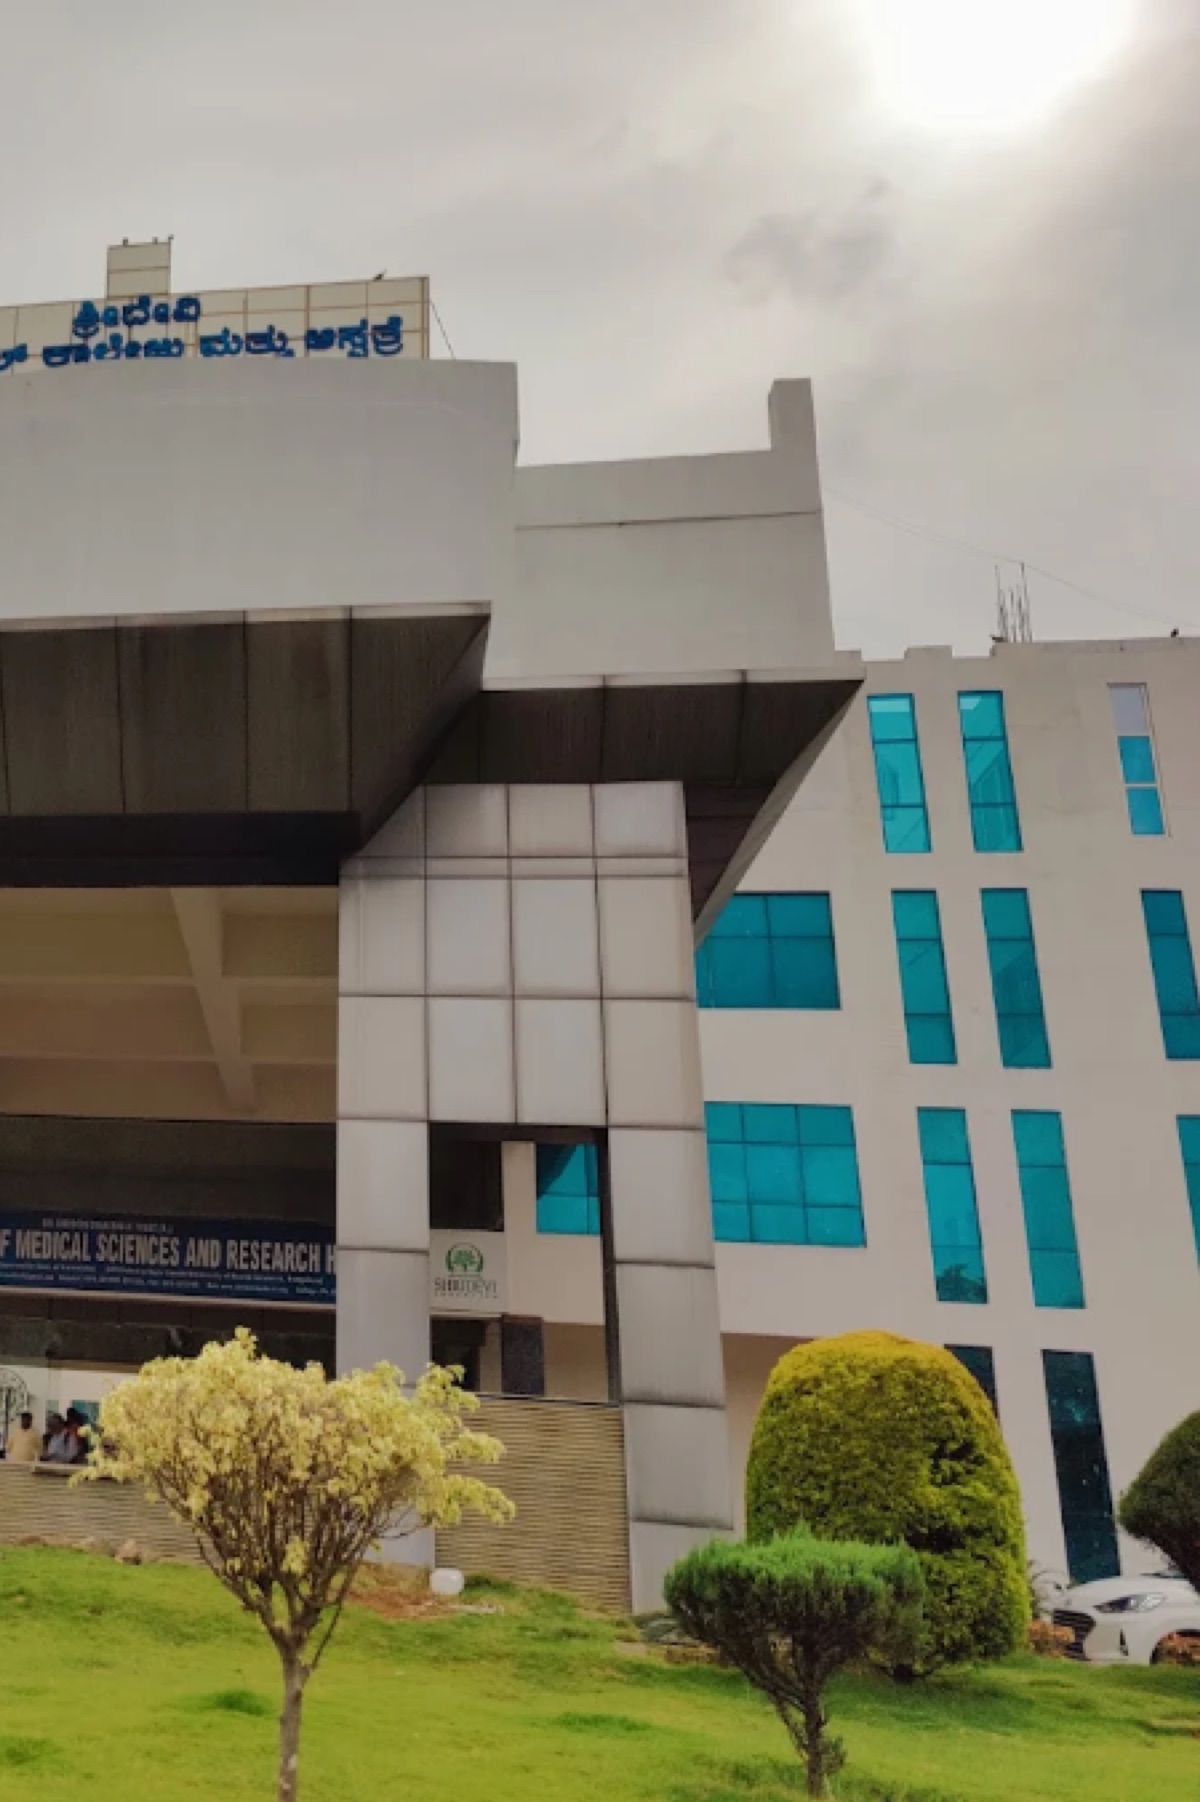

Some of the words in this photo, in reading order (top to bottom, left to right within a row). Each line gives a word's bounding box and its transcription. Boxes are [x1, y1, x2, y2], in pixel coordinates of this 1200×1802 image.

[72, 295, 201, 338] ಶ್ರೀದೇವಿ
[15, 1229, 91, 1263] MEDICAL
[95, 1234, 181, 1268] SCIENCES
[185, 1237, 222, 1270] AND
[226, 1240, 321, 1274] RESEARCH
